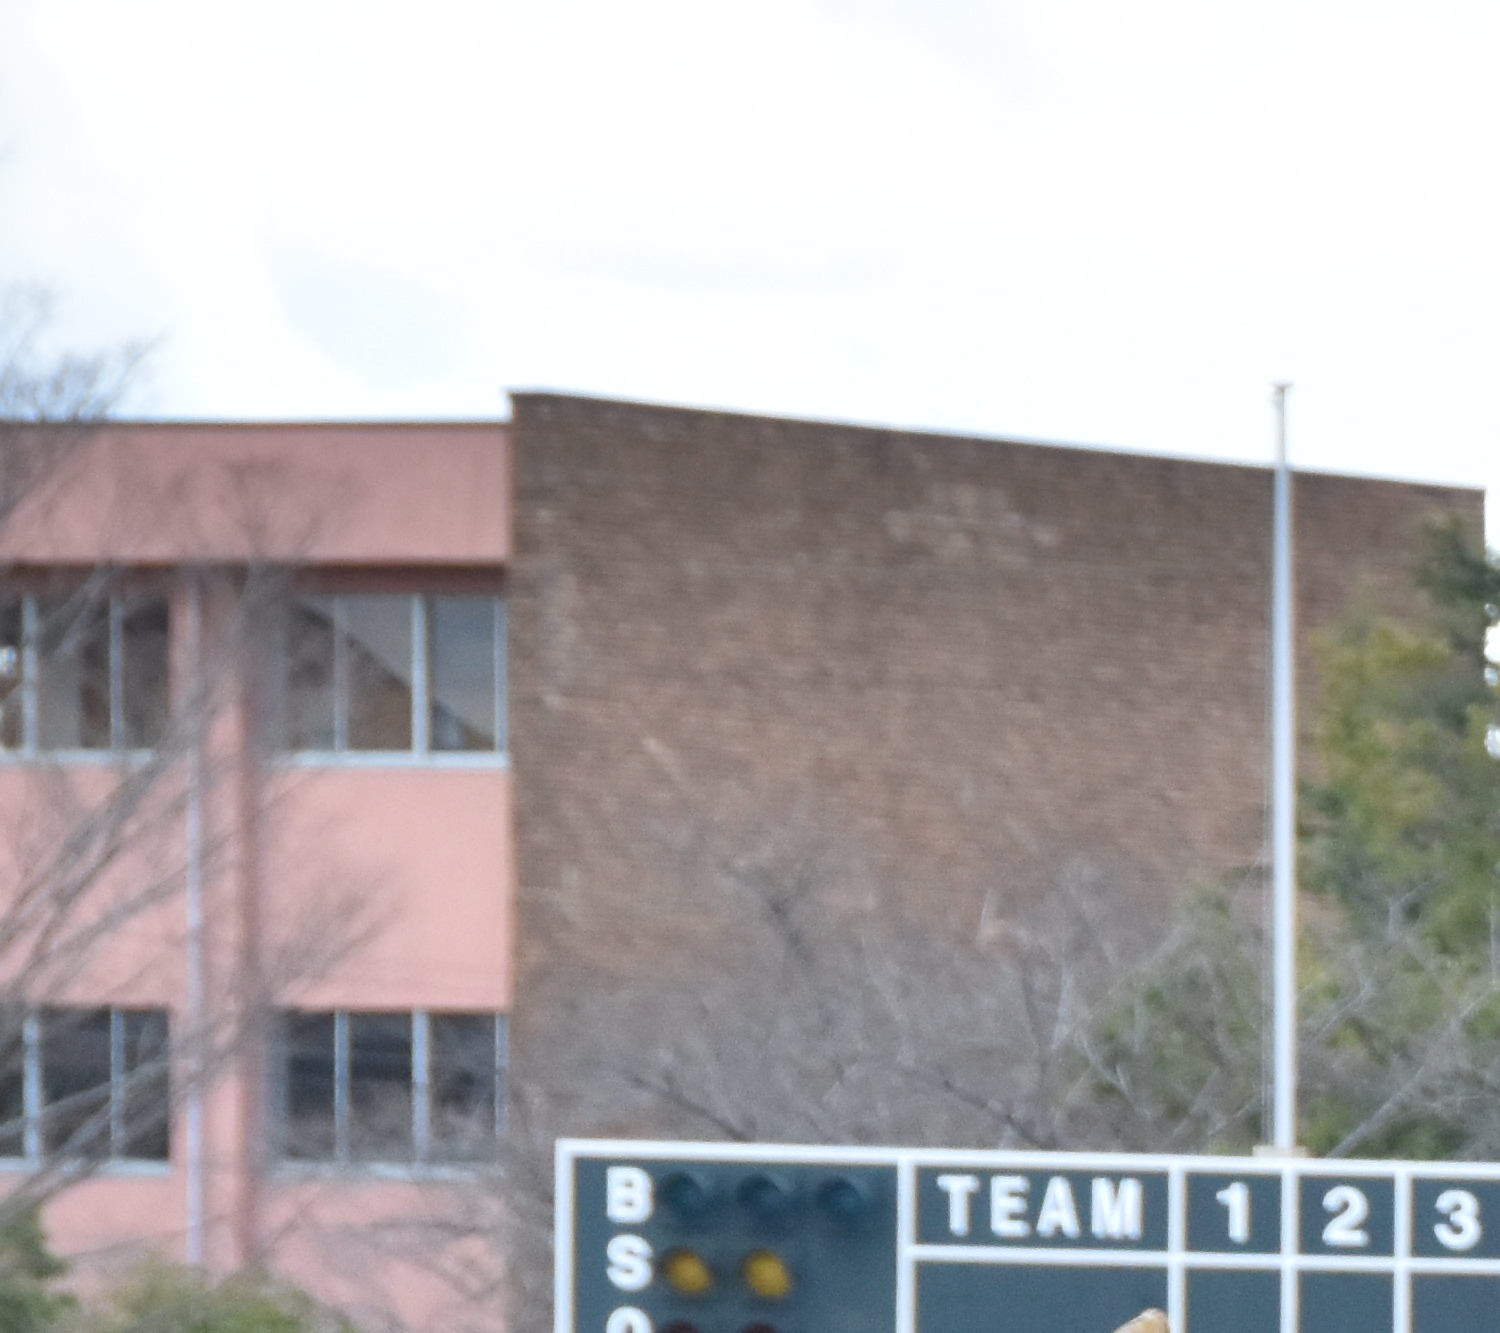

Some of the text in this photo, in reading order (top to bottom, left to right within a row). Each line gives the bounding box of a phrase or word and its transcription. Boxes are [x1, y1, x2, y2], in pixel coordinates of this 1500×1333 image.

[605, 1165, 653, 1225] B
[936, 1174, 1143, 1240] TEAM
[1216, 1181, 1249, 1243] 1
[1321, 1185, 1368, 1247] 2
[1433, 1189, 1481, 1250] 3
[605, 1234, 653, 1292] S
